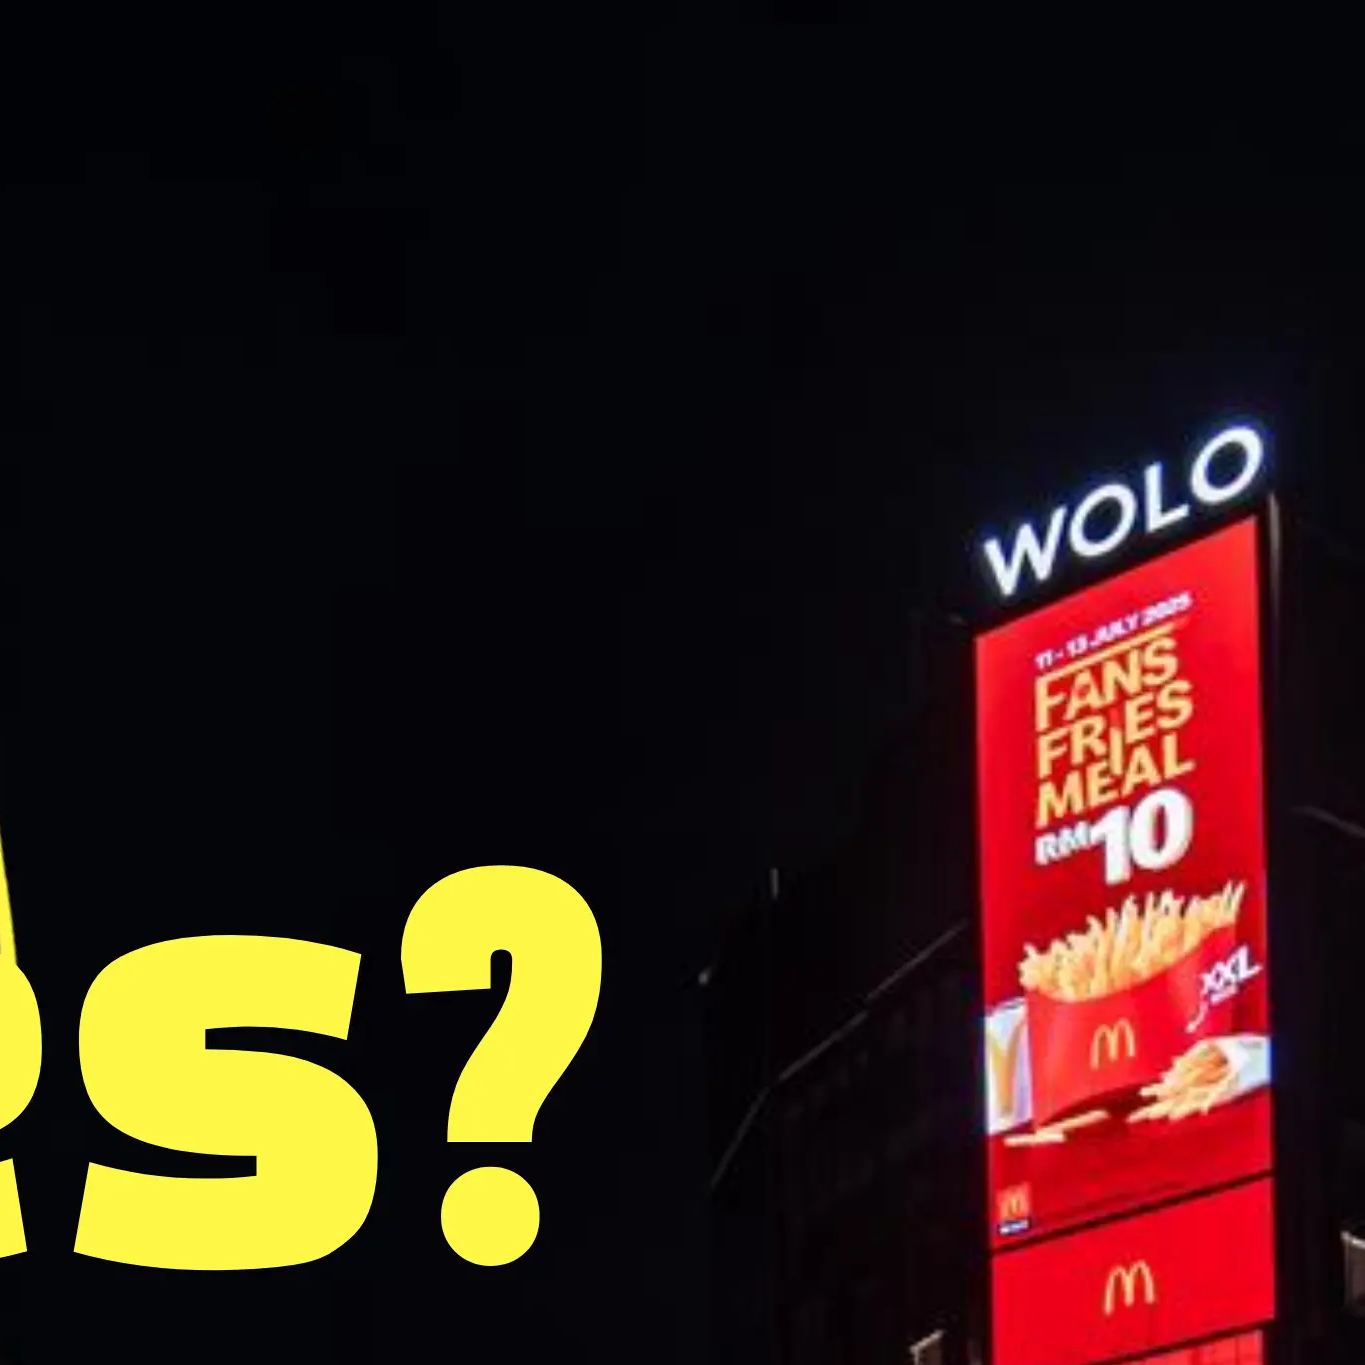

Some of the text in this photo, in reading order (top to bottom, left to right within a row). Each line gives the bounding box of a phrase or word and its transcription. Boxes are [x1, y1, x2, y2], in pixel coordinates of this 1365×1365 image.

[983, 426, 1264, 597] WOLO
[1035, 621, 1181, 732] FANS
[1036, 731, 1195, 829] MEAL
[1037, 680, 1193, 780] FRIES
